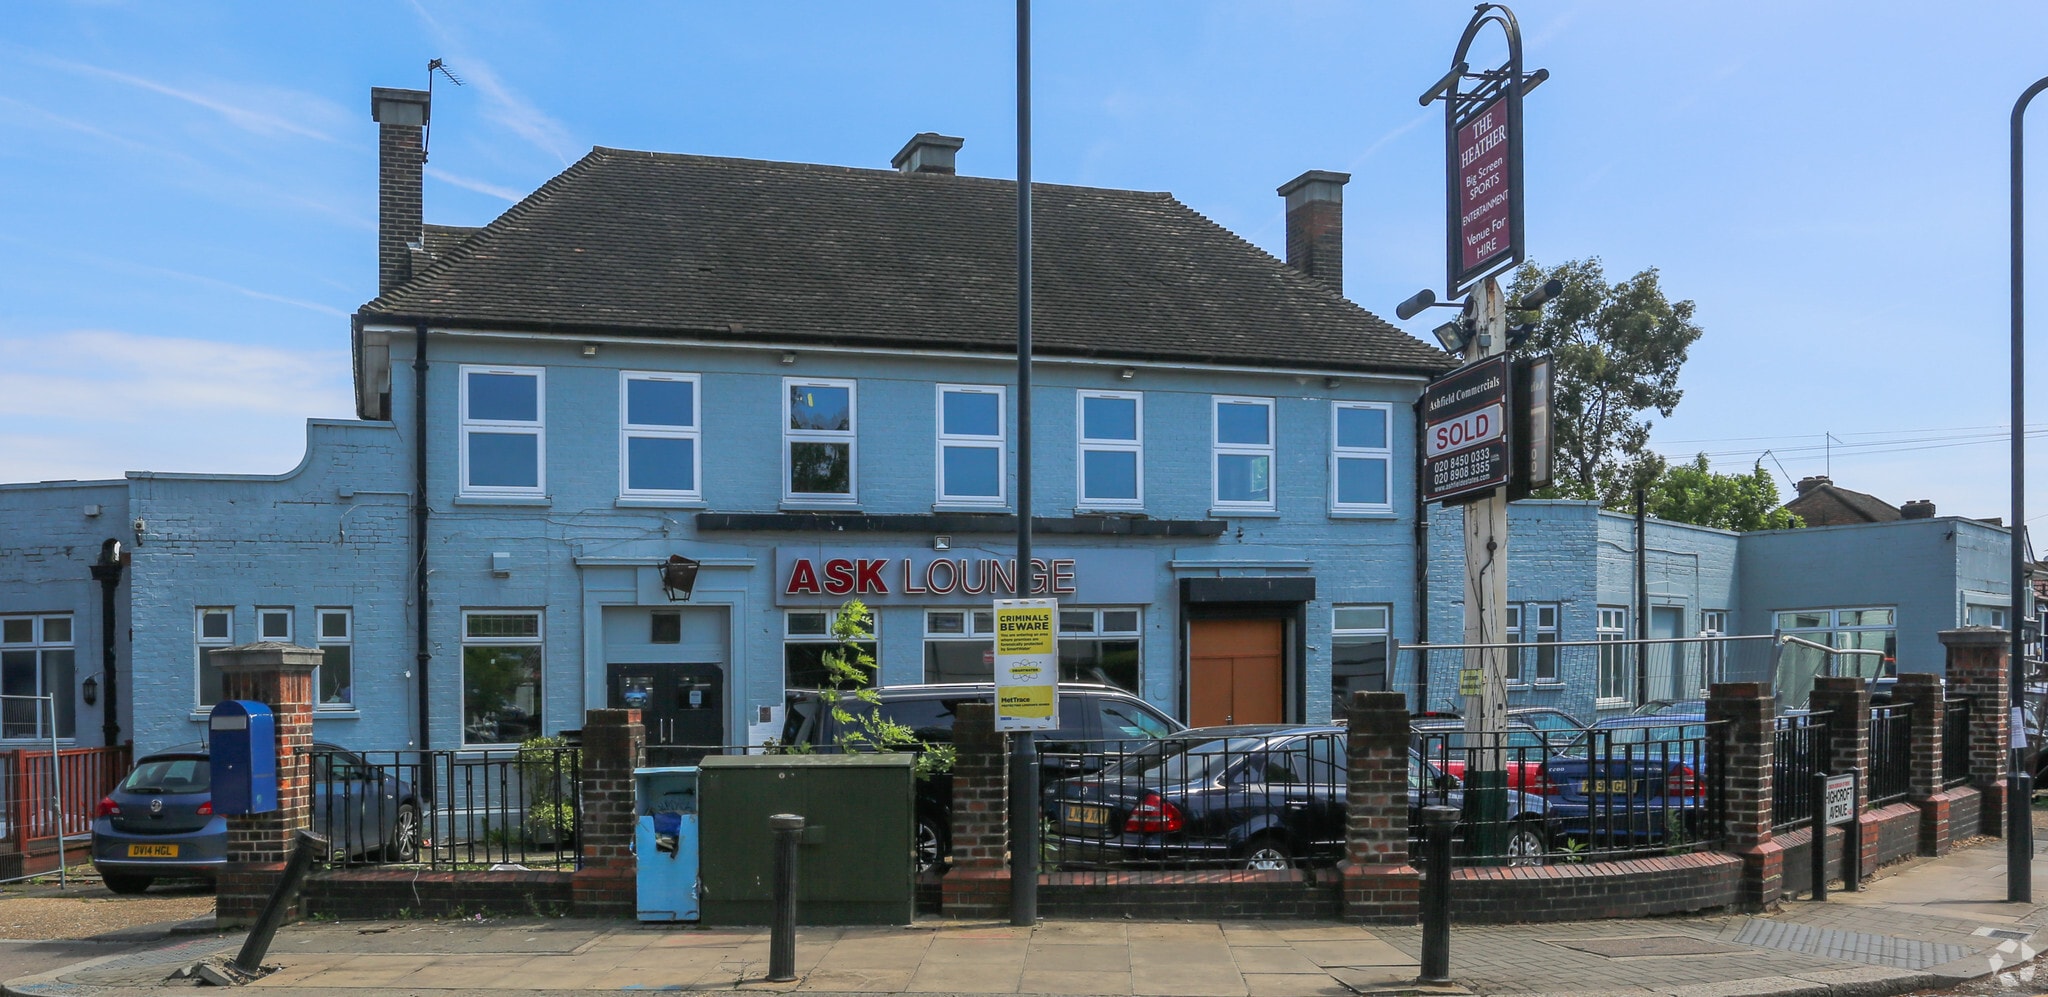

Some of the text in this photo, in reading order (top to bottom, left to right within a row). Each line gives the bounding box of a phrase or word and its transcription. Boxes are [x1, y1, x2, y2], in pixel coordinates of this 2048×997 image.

[1472, 112, 1493, 140] THE
[1461, 124, 1507, 169] HEATHER
[1466, 157, 1503, 188] Big Screen
[1470, 172, 1500, 201] SPORTS
[1462, 189, 1509, 227] ENTERTAINMENT
[1466, 216, 1507, 246] Venue For
[1476, 237, 1497, 259] HIRE
[1429, 376, 1500, 412] Ashfield Commercials
[1436, 414, 1489, 450] SOLD
[1434, 459, 1449, 473] 020
[1450, 454, 1469, 470] 8450
[1470, 447, 1490, 462] 0333
[1434, 461, 1490, 485] 020 8908 3355
[786, 557, 1077, 595] ASK LOUNGE
[1000, 614, 1049, 622] CRIMINALS
[1000, 622, 1049, 631] BEWARE
[1829, 803, 1848, 819] AVENUE
[133, 846, 172, 856] DV14 HGL
